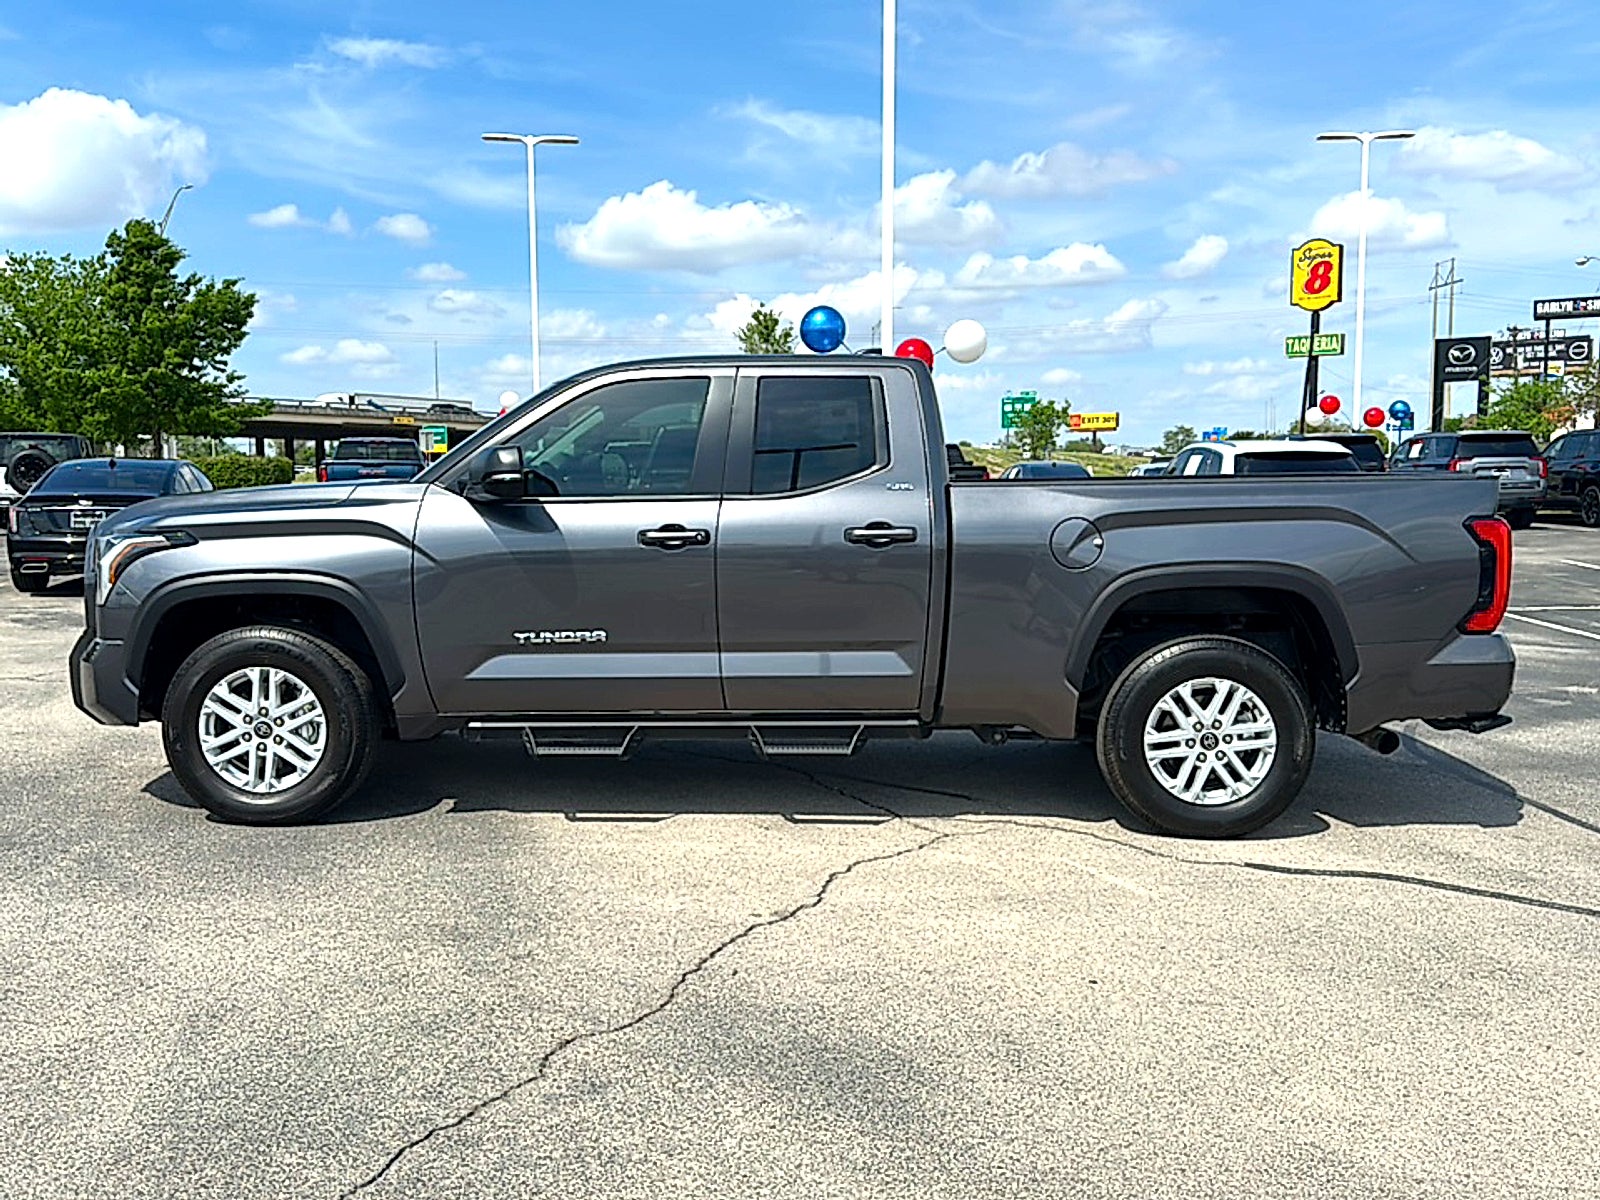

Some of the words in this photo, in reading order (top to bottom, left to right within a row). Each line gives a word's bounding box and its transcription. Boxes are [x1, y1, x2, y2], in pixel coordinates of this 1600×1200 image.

[1304, 260, 1333, 295] 8
[1081, 416, 1100, 424] EXIT
[513, 630, 607, 645] TUNDRA
